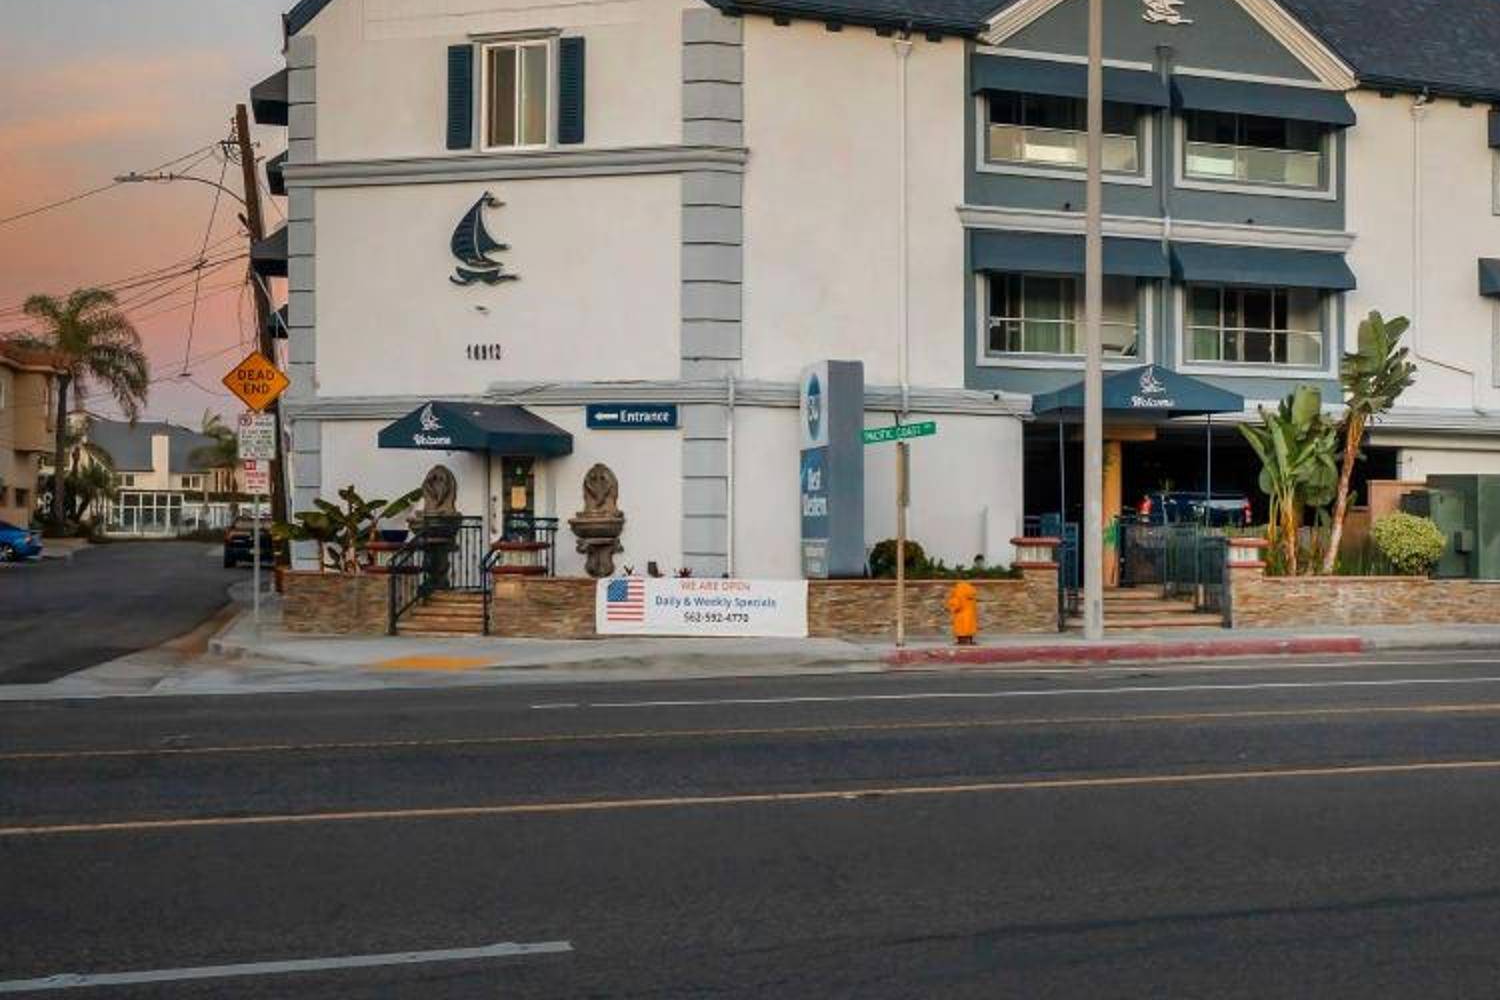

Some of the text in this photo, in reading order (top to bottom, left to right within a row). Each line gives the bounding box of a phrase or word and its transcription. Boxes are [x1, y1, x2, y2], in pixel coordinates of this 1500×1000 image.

[237, 369, 275, 381] DEAD
[243, 382, 270, 394] END
[620, 409, 672, 423] Entrance
[681, 581, 751, 591] WE ARE OPEN
[655, 595, 777, 609] Daily & Weekly Specials
